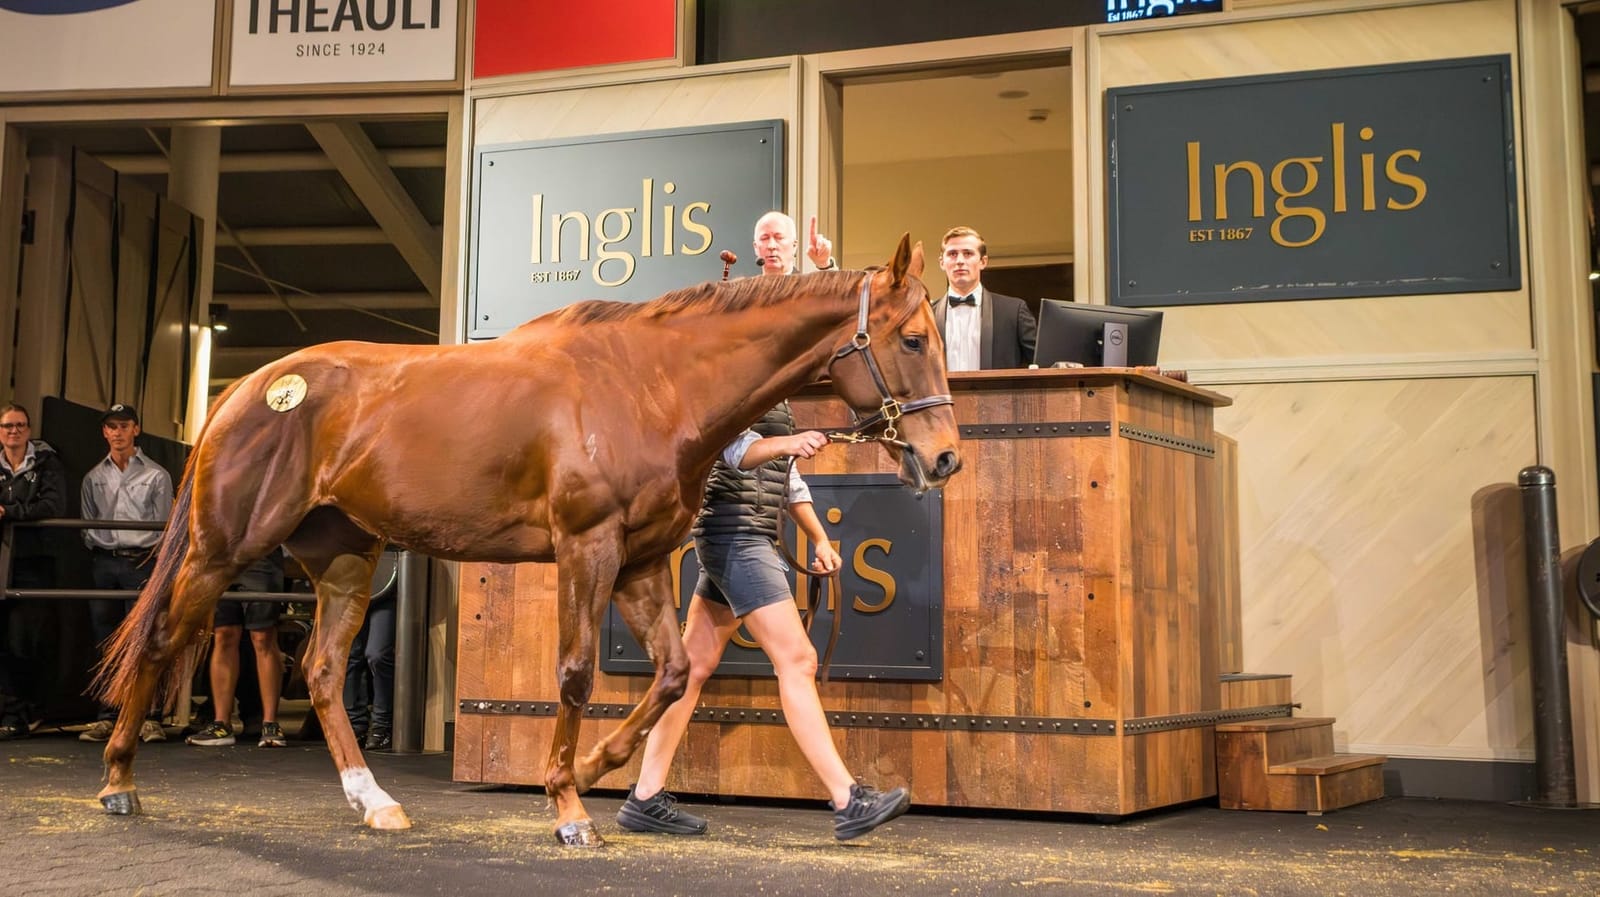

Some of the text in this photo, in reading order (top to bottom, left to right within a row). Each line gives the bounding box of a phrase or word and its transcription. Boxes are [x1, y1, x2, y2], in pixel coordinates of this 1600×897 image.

[296, 42, 386, 57] SINCE 1924
[1186, 122, 1427, 248] Inglis
[530, 177, 714, 288] Inglis
[1189, 227, 1253, 242] EST 1867
[531, 269, 582, 284] EST 1867
